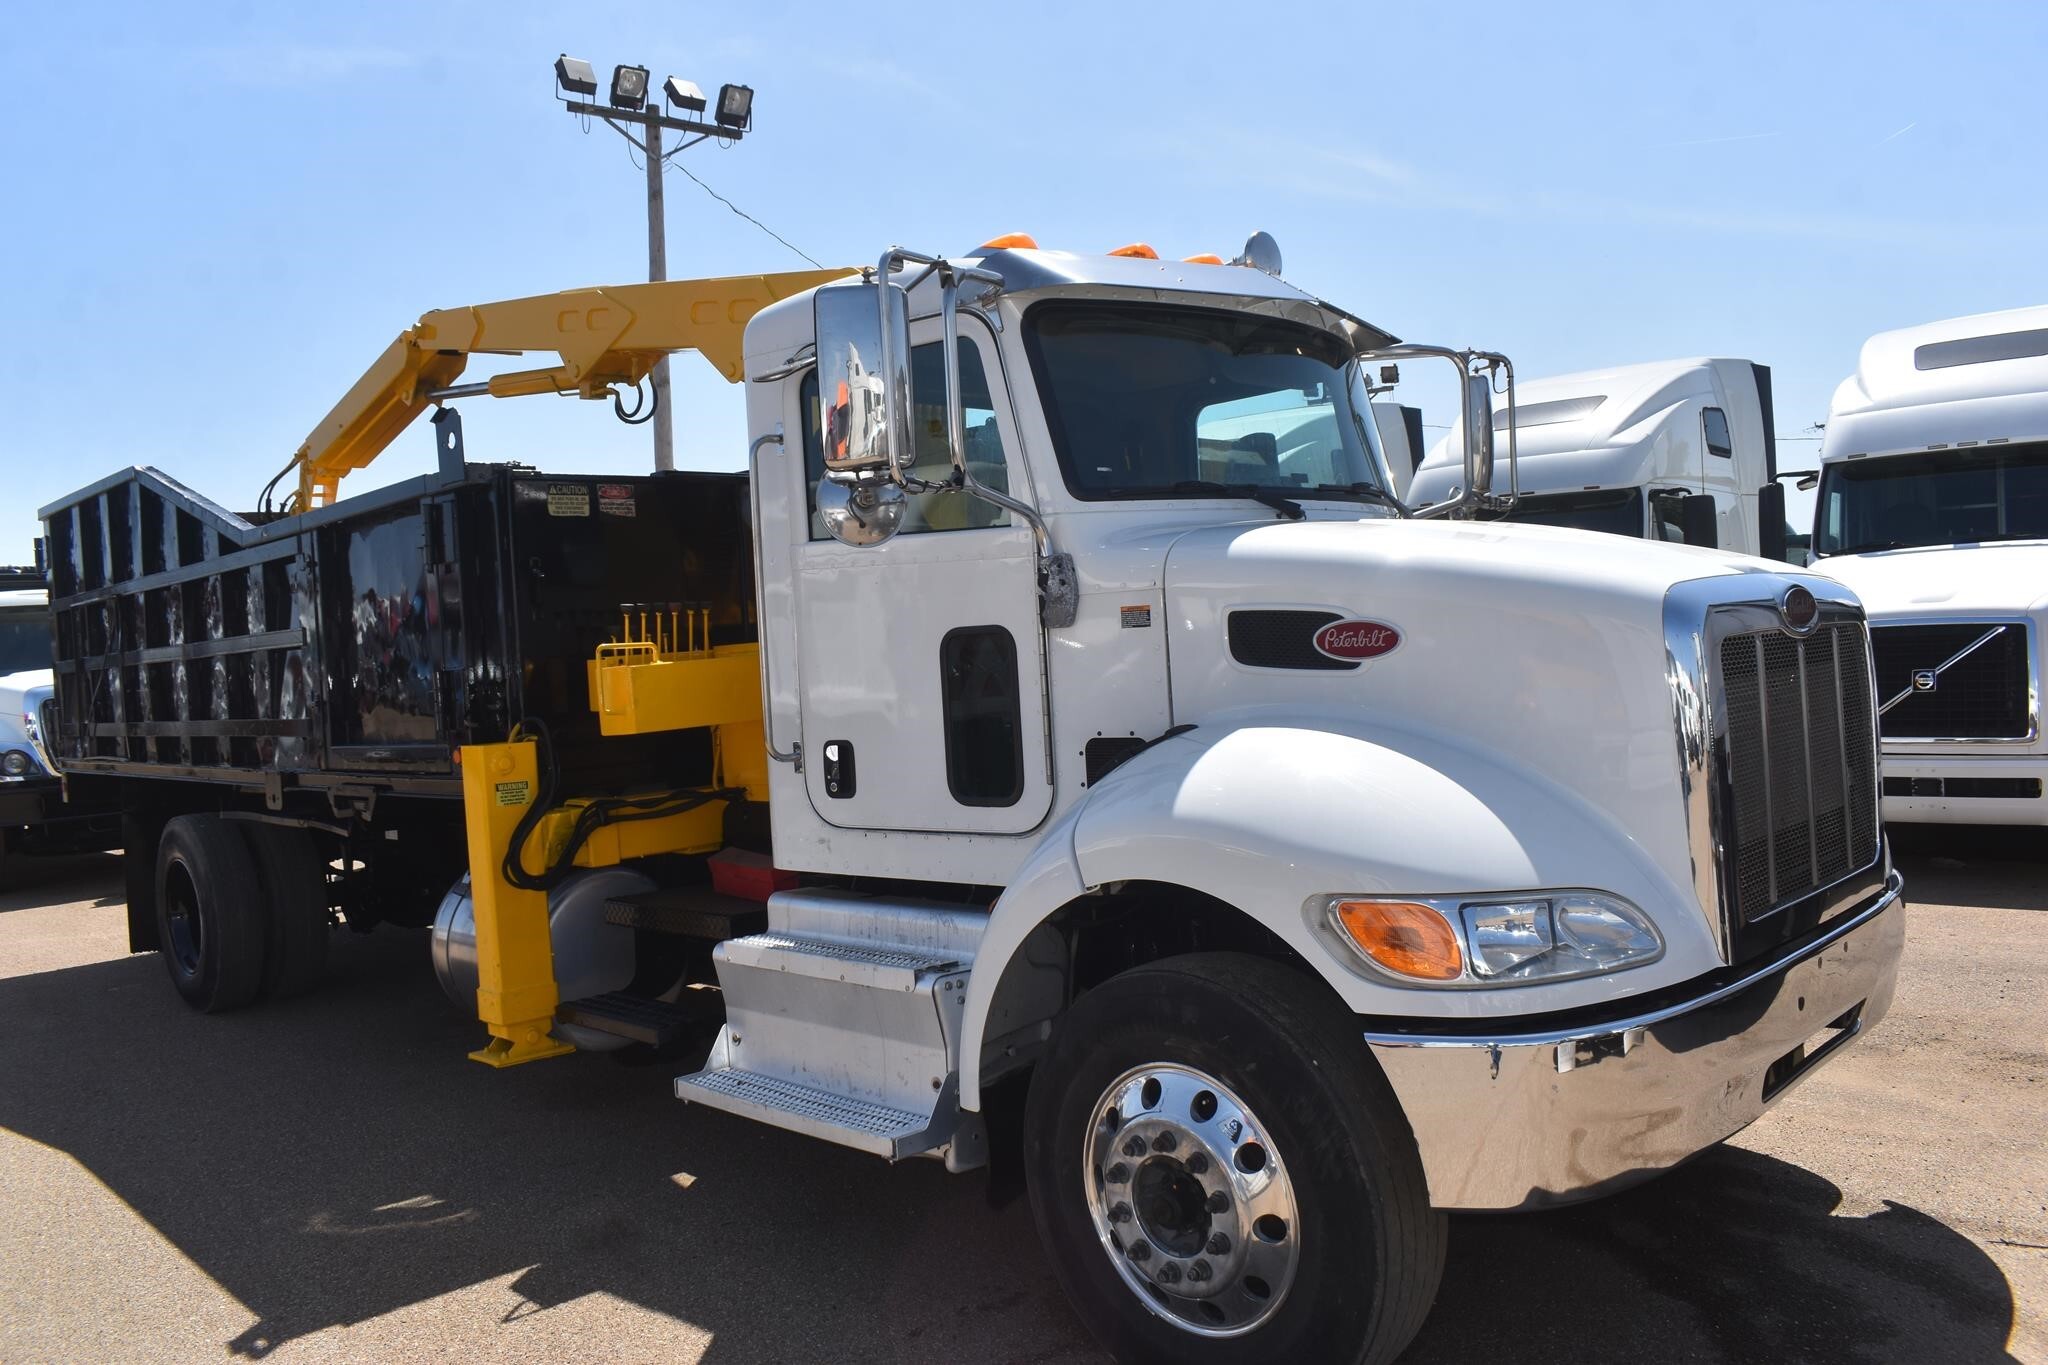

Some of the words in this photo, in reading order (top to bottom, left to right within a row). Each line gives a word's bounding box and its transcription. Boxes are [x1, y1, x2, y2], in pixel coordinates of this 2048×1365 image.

[556, 485, 587, 494] CAUTION
[1324, 628, 1392, 650] Peterbilt
[498, 782, 527, 791] WARNING
